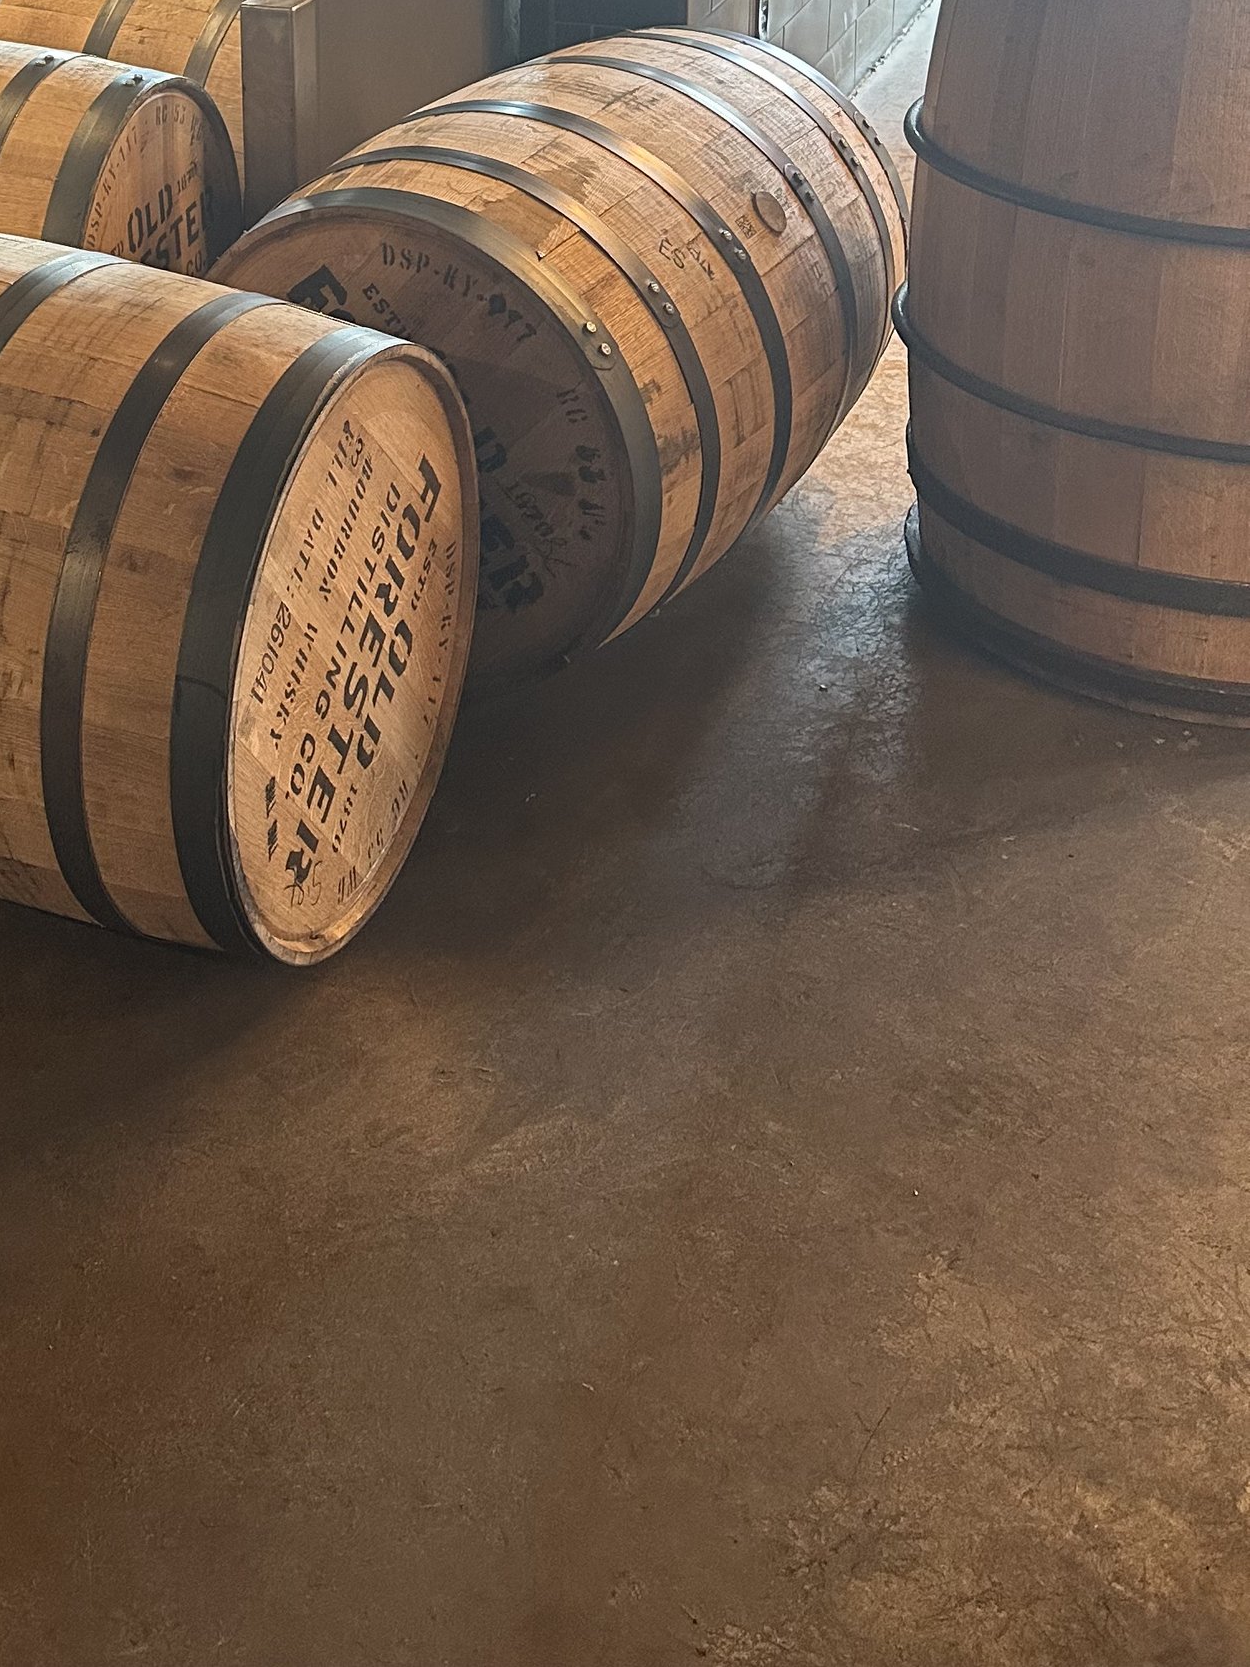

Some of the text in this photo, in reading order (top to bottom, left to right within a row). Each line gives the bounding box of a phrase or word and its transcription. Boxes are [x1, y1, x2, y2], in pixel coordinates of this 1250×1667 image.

[155, 104, 168, 126] RC
[127, 183, 173, 254] OLD
[325, 419, 354, 487] FILL
[269, 456, 373, 751] BOURBON WHISKY
[314, 481, 401, 721] DISTILLING
[285, 452, 443, 885] FORESTER
[331, 537, 438, 854] ESTD OLD 1870
[284, 732, 316, 800] CO.
[390, 779, 409, 821] RC
